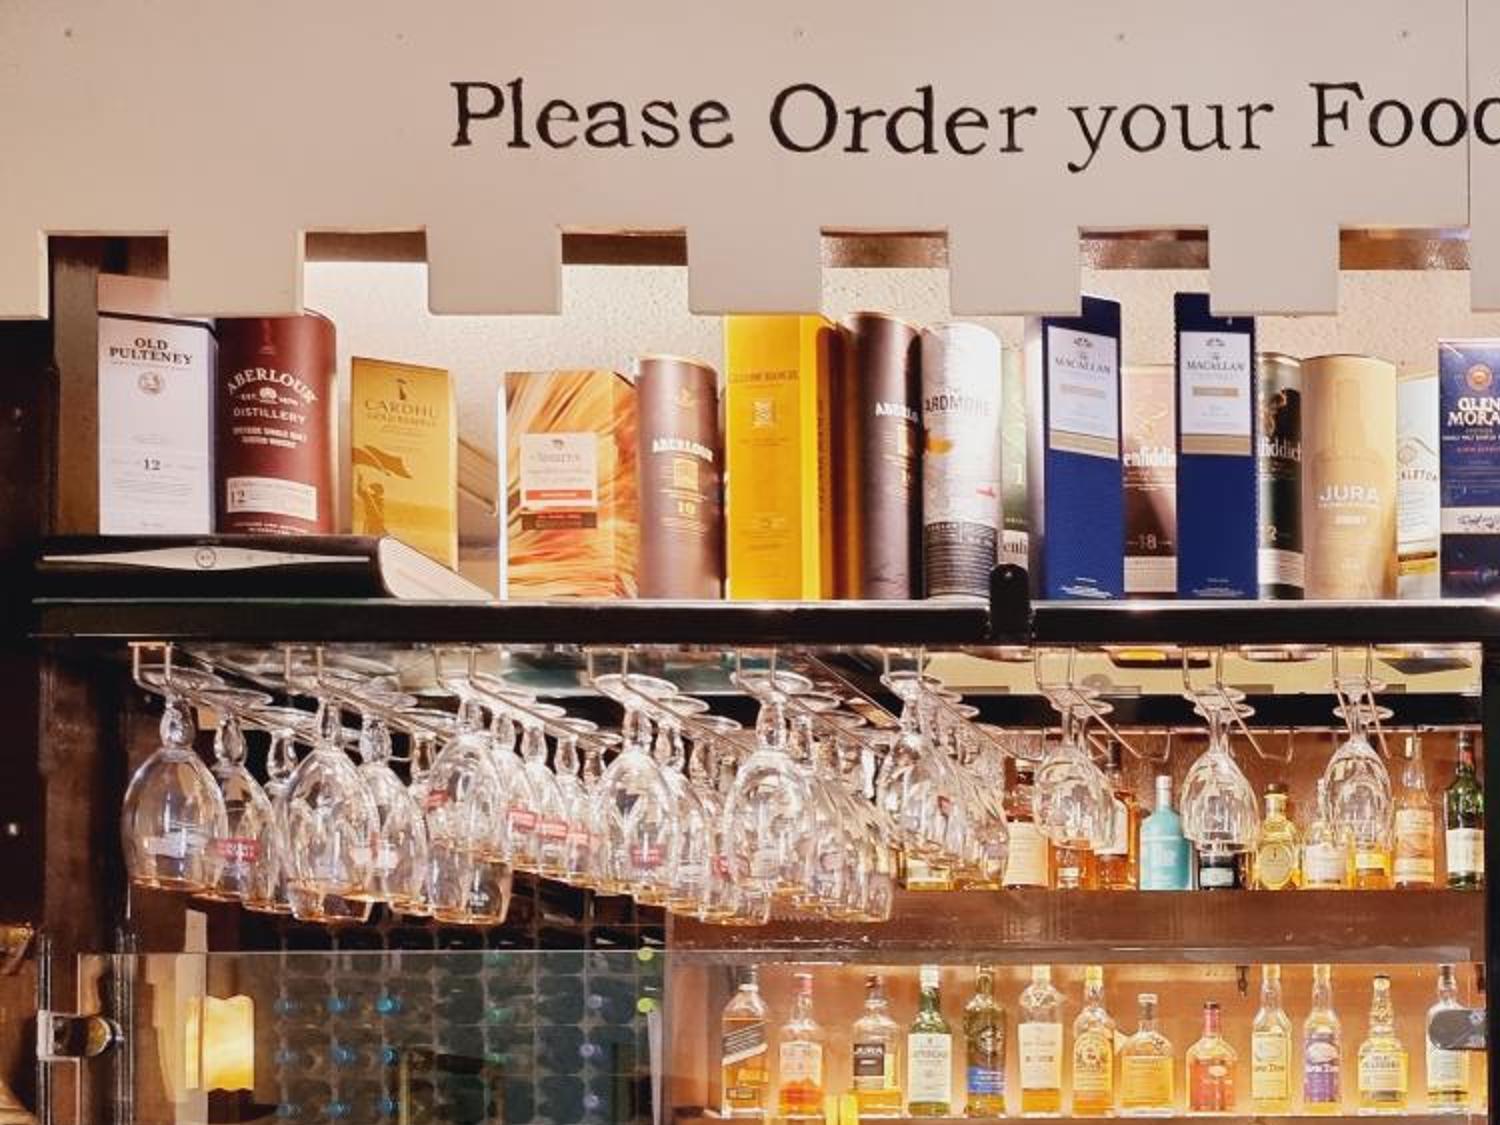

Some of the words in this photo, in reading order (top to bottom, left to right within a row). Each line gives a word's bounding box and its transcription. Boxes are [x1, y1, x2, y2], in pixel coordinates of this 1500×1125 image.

[452, 78, 734, 149] Please
[768, 84, 1037, 156] Order
[1067, 93, 1275, 173] your
[134, 337, 169, 351] OLD
[109, 346, 193, 365] PULTENEY
[1055, 357, 1112, 375] MACALLAN
[1186, 360, 1246, 372] MACALLAN
[226, 366, 319, 404] ABERLOUR
[233, 406, 306, 426] DISTILLERY
[143, 458, 161, 471] 12
[1319, 483, 1381, 502] JURA
